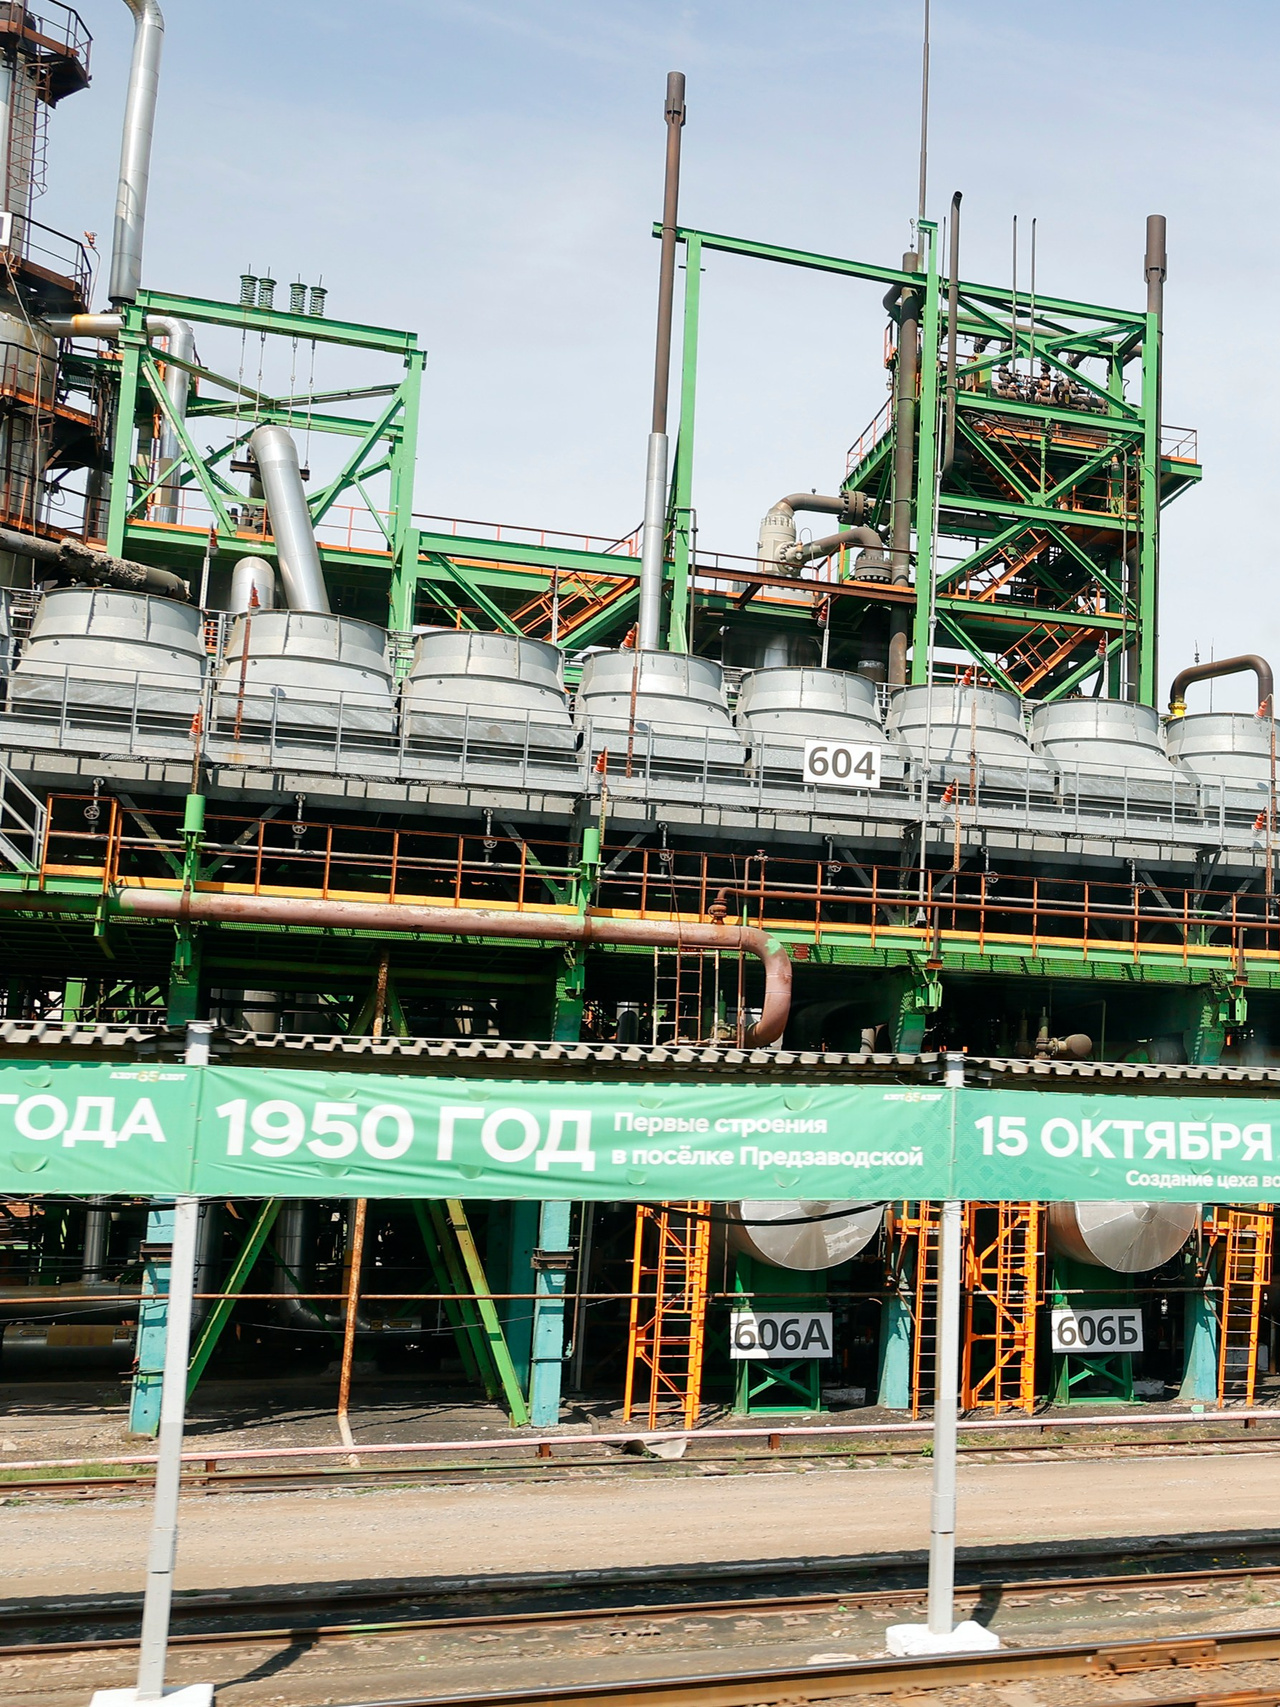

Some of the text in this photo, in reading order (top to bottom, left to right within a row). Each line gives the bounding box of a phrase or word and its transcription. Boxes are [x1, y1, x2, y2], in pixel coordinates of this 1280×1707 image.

[808, 746, 876, 781] 604
[215, 1098, 596, 1172] 1950 ГОД
[613, 1111, 828, 1138] Первые строения
[974, 1115, 1029, 1157] 15
[1040, 1117, 1273, 1161] ОКТЯБРЯ
[611, 1145, 924, 1171] в посёлке Предзаводской
[1125, 1169, 1214, 1189] Создание
[1217, 1174, 1259, 1189] цеха
[733, 1317, 831, 1351] 606А
[1056, 1314, 1139, 1347] 606Б
